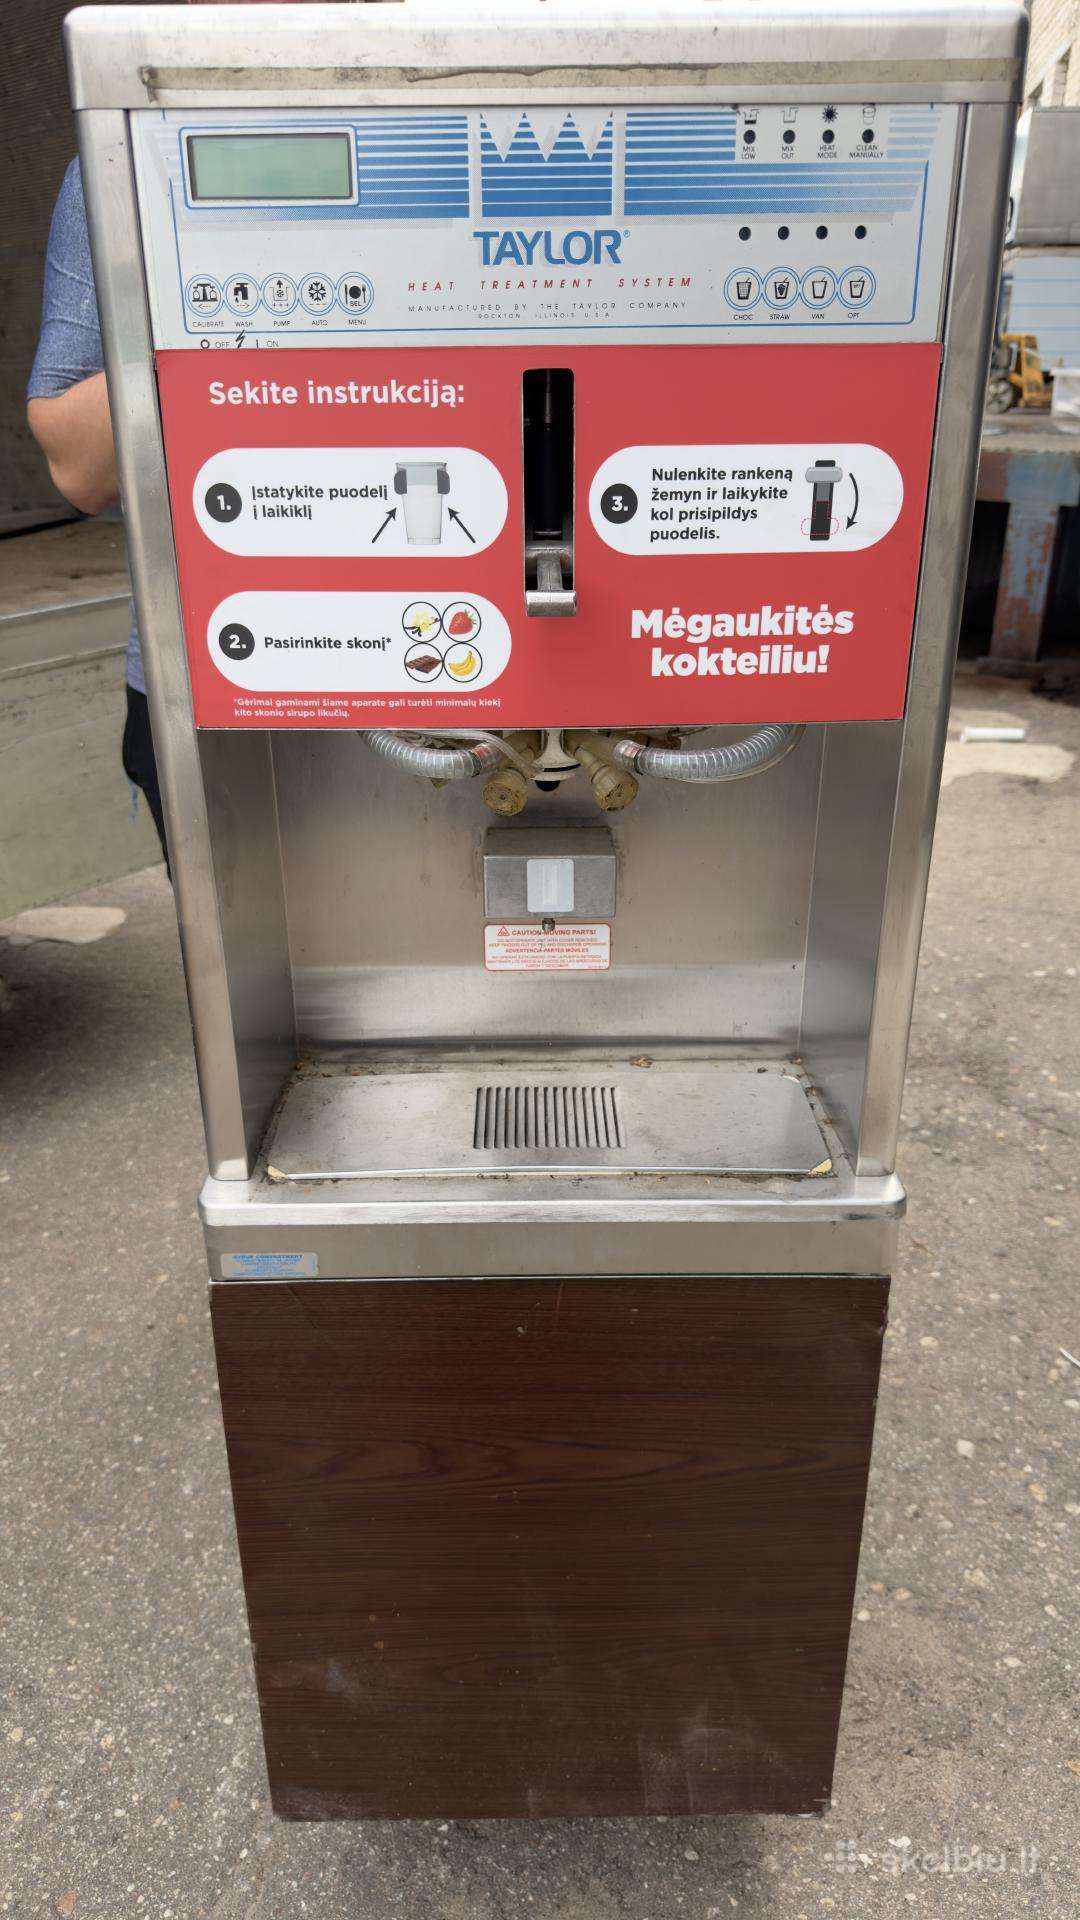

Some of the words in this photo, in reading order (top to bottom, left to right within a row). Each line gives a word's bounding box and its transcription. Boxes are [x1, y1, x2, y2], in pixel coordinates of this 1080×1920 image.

[408, 282, 455, 291] HEAT
[480, 279, 592, 289] TREATMENT
[618, 278, 691, 288] SYSTEM
[208, 380, 298, 404] Sekite
[308, 379, 465, 408] instrukciją:
[652, 468, 728, 481] Nulenkite
[731, 468, 793, 483] rankeną
[251, 485, 324, 501] Įstatykite
[328, 484, 388, 501] puodelį
[651, 486, 702, 503] žemyn
[706, 488, 718, 500] ir
[722, 486, 788, 503] laikykite
[216, 494, 232, 511] 1.
[611, 496, 628, 512] 3.
[252, 505, 259, 520] į
[262, 504, 313, 520] laikiklį
[650, 508, 674, 521] kol
[678, 506, 758, 524] prisipildys
[650, 526, 720, 543] puodelis.
[630, 604, 854, 644] Mėgaukitės
[229, 634, 247, 650] 2.
[264, 636, 342, 650] Pasirinkite
[651, 645, 830, 677] kokteiliu!
[276, 698, 320, 708] gaminami
[351, 699, 386, 708] aparate
[388, 698, 405, 708] gali
[234, 709, 252, 717] kito
[254, 709, 284, 717] skonio
[286, 709, 316, 719] sirupo
